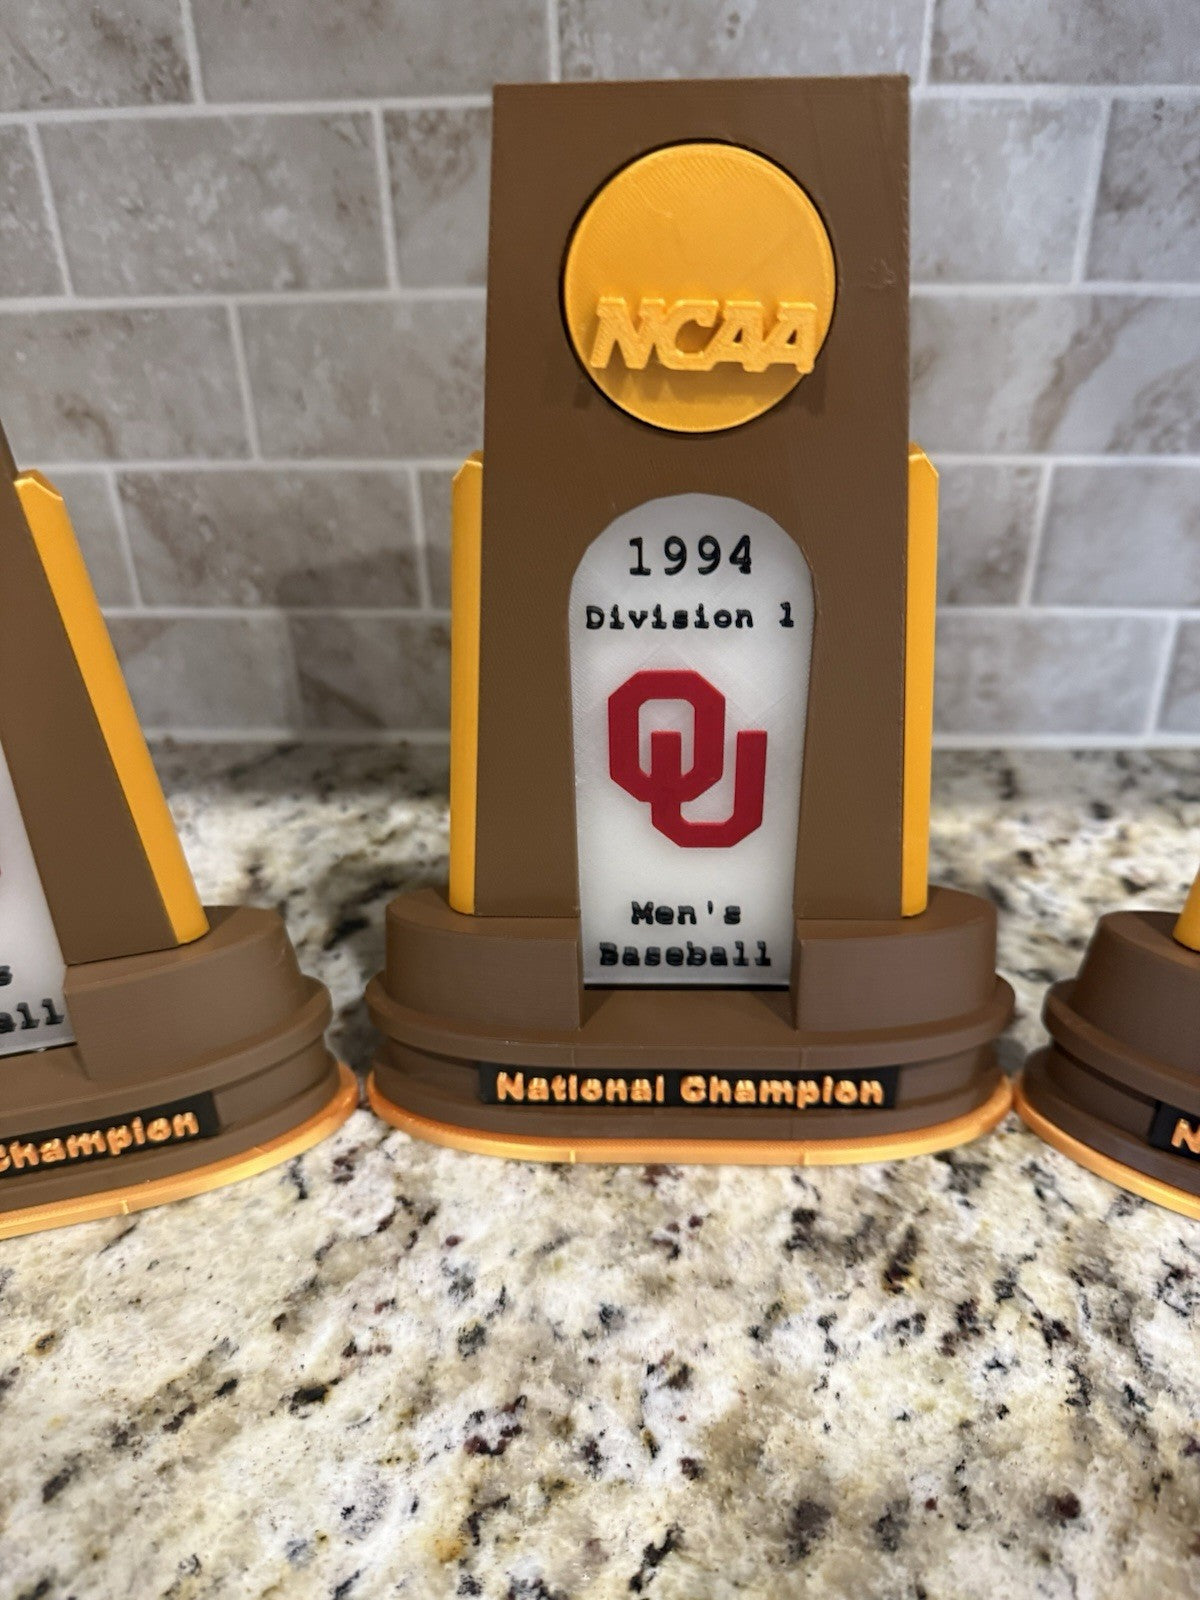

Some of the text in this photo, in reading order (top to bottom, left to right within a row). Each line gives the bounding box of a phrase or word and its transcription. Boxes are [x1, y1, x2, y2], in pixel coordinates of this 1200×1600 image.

[590, 296, 817, 374] NCAA
[628, 534, 752, 576] 1994
[586, 605, 754, 630] Division
[608, 669, 768, 848] OU
[631, 900, 741, 926] Men's
[600, 942, 771, 967] Baseball
[497, 1071, 884, 1109] National Champion
